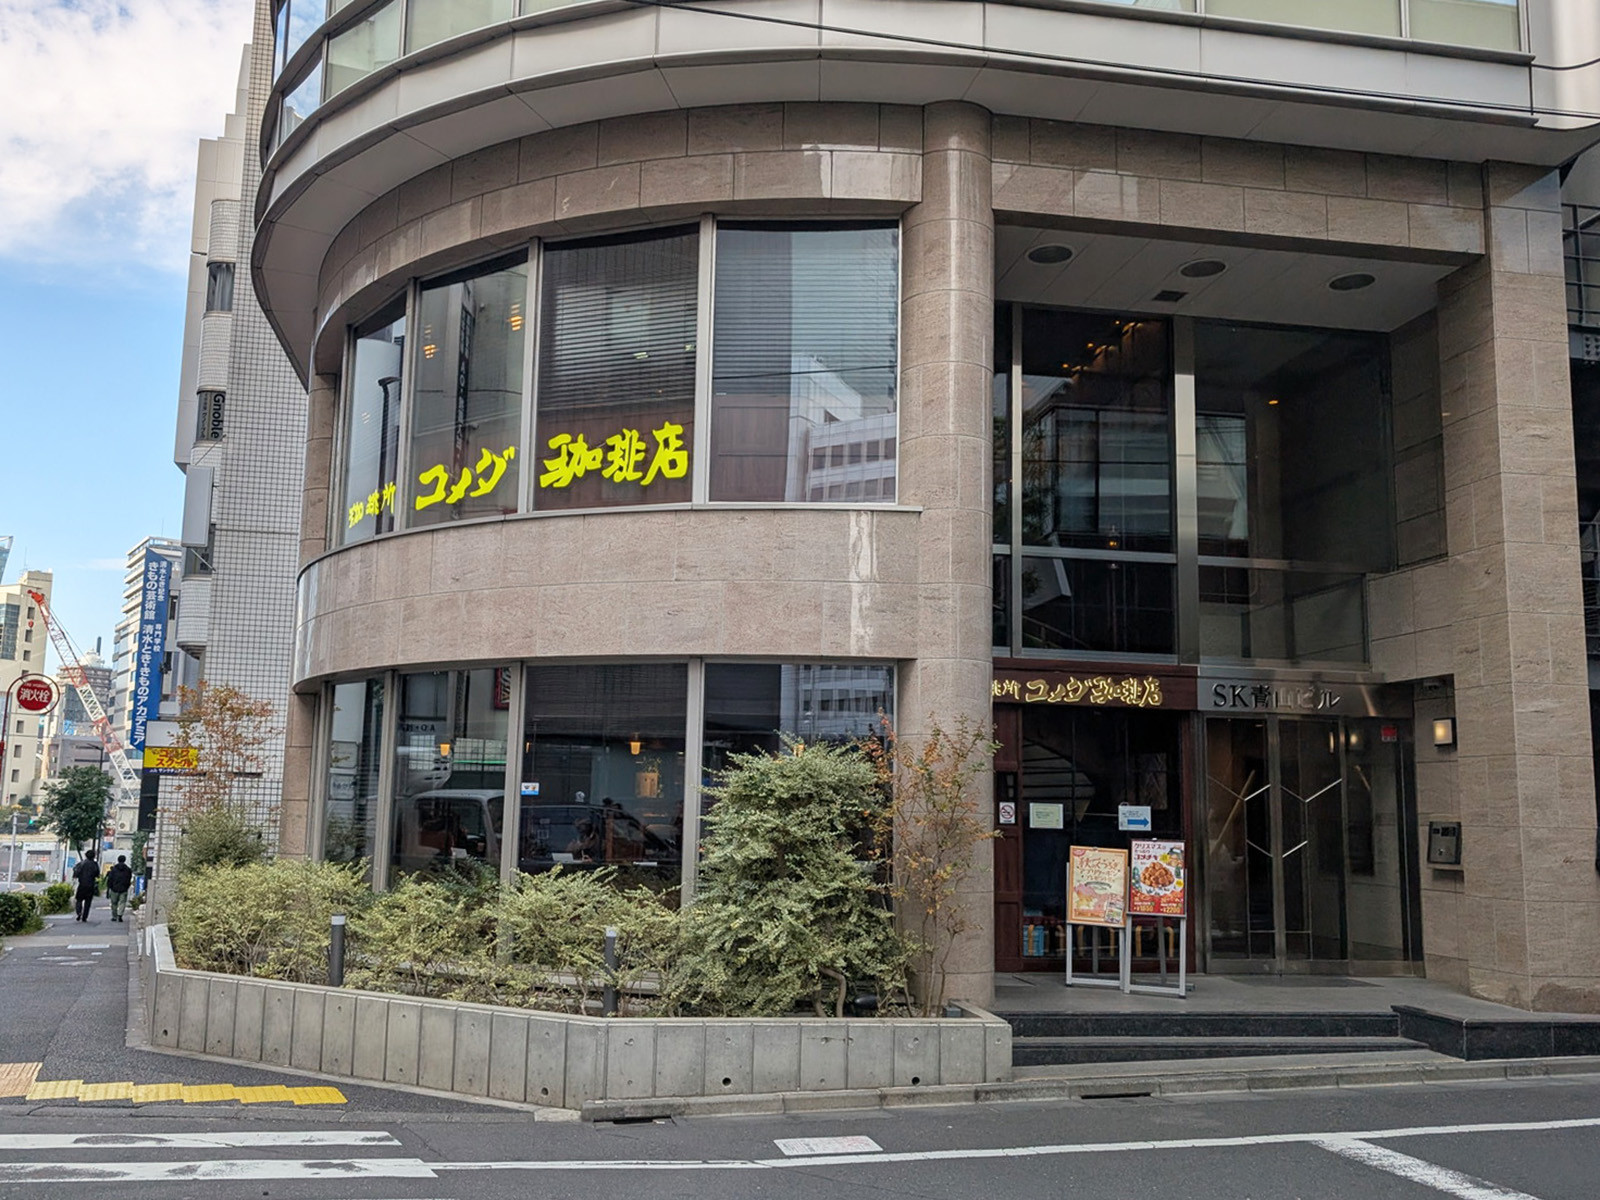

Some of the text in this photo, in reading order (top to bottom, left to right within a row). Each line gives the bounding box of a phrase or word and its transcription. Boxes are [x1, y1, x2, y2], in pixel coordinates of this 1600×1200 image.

[210, 393, 225, 438] Gnoble
[415, 446, 515, 511] コメダ
[539, 421, 689, 488] 珈琲店
[143, 561, 159, 620] きもの芸術館
[153, 623, 162, 652] 専門学校
[19, 687, 51, 703] 消火栓
[1025, 676, 1163, 707] コメダ珈琲店
[1212, 683, 1341, 710] SK青山ビル
